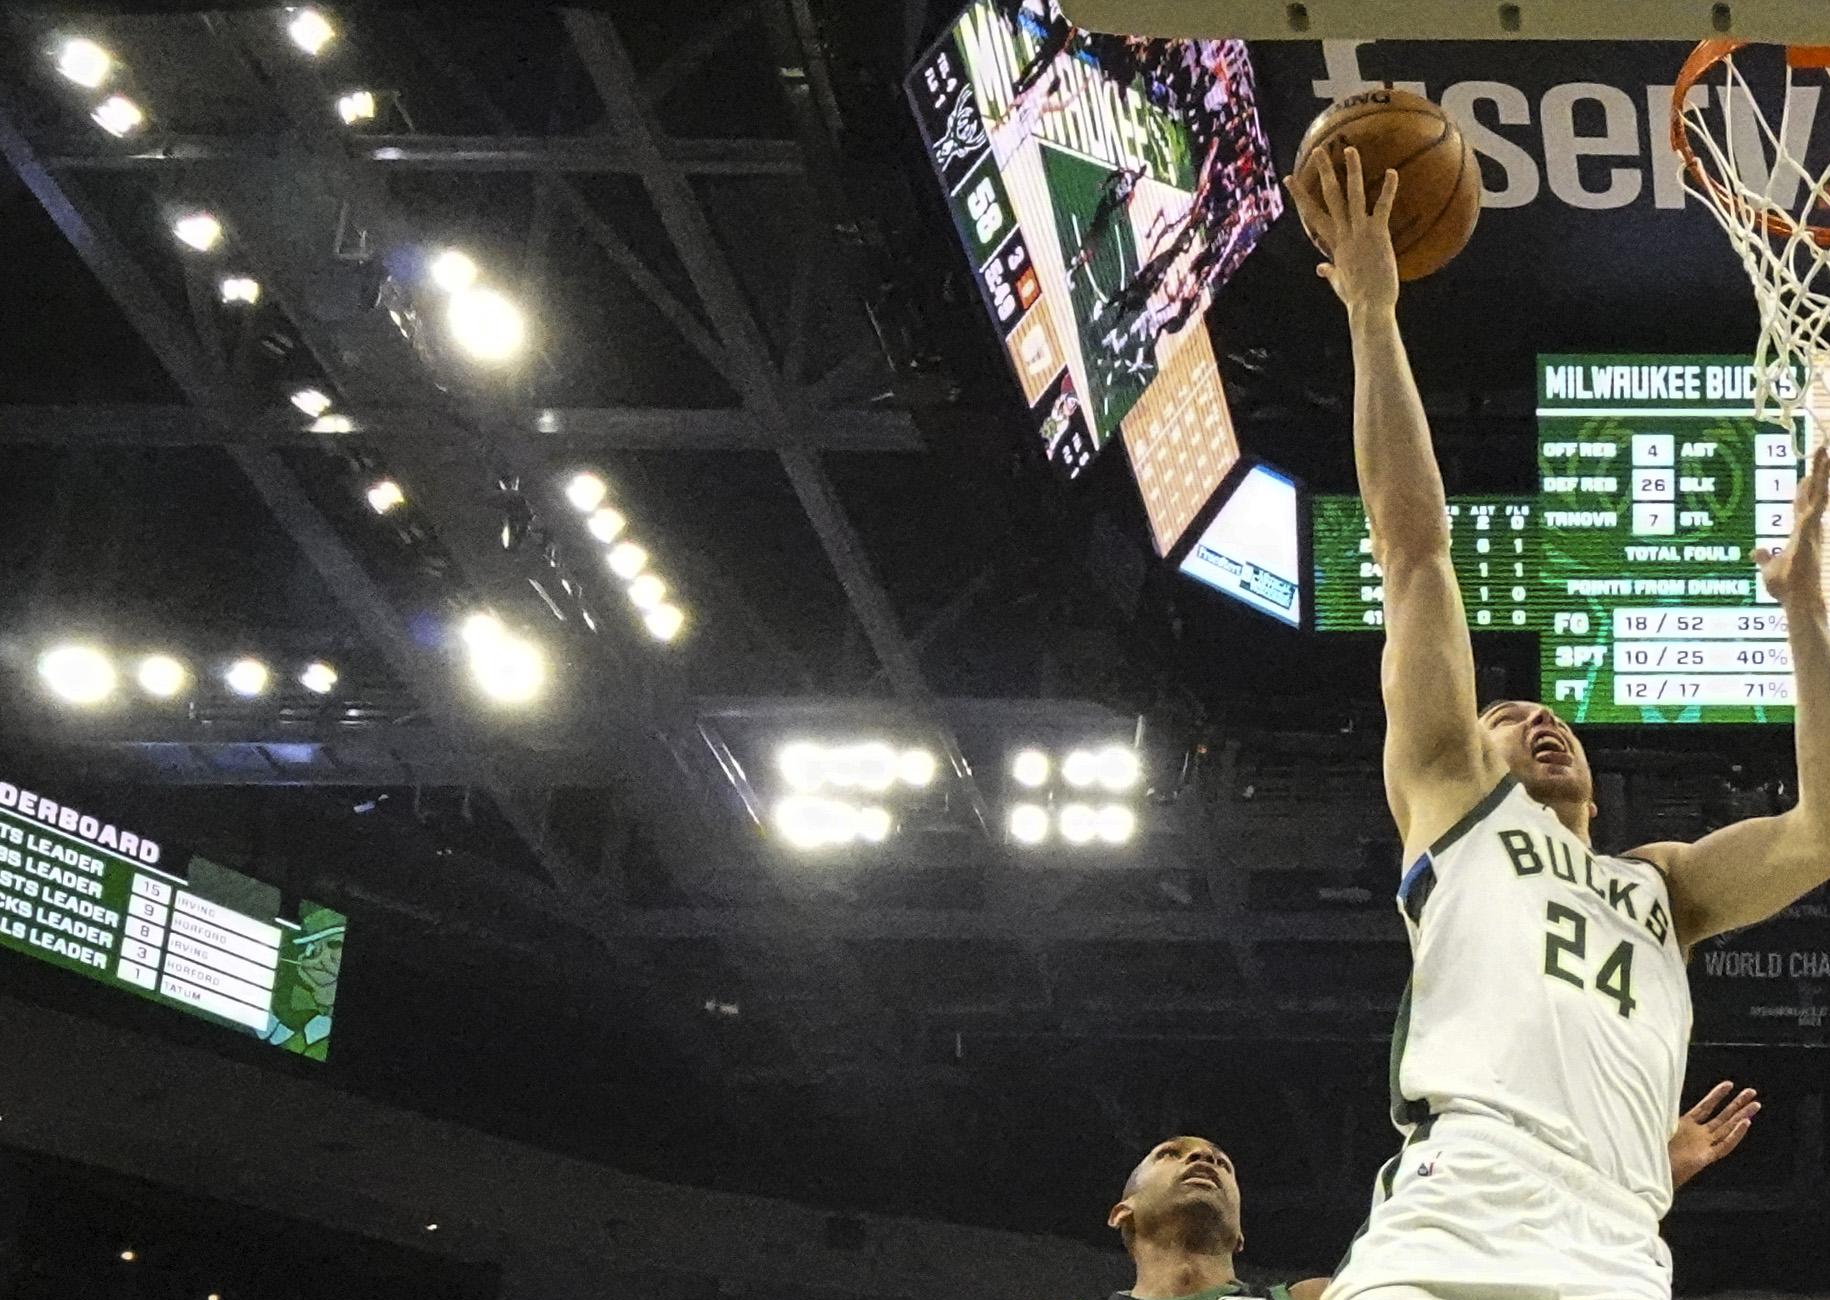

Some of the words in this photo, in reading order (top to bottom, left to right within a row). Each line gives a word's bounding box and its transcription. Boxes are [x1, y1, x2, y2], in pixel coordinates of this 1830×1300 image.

[967, 177, 1003, 244] 58
[1546, 366, 1700, 399] MILWAUKEE
[1706, 366, 1797, 399] BUCS
[1648, 445, 1658, 457] 4
[1767, 445, 1787, 457] 13
[1641, 479, 1665, 491] 26
[1774, 480, 1780, 491] 1
[1650, 515, 1659, 526] 7
[1771, 514, 1782, 527] 2
[1624, 547, 1681, 561] TOTAL
[1625, 616, 1647, 630] 18
[1677, 616, 1704, 630] 52
[1738, 615, 1788, 631] 35%
[1625, 650, 1648, 665] 10
[1677, 650, 1704, 665] 25
[1736, 648, 1788, 665] 40%
[1625, 683, 1647, 698] 12
[1681, 683, 1701, 698] 17
[1744, 681, 1788, 698] 71%
[27, 833, 104, 877] LEADER
[25, 857, 103, 899] LEADER
[1497, 828, 1669, 946] BUCKS
[41, 884, 119, 928] LEADER
[143, 880, 160, 897] 15
[178, 896, 216, 918] IRVING
[36, 905, 113, 949] LEADER
[143, 905, 154, 917] 9
[173, 917, 228, 945] HORFORD
[29, 927, 107, 971] LEADER
[140, 926, 150, 938] 8
[170, 938, 209, 961] IRVING
[1544, 899, 1637, 1020] 24
[137, 946, 148, 960] 3
[166, 959, 221, 987] HORFORD
[1704, 951, 1783, 978] WORLD
[163, 980, 202, 1001] TATUM
